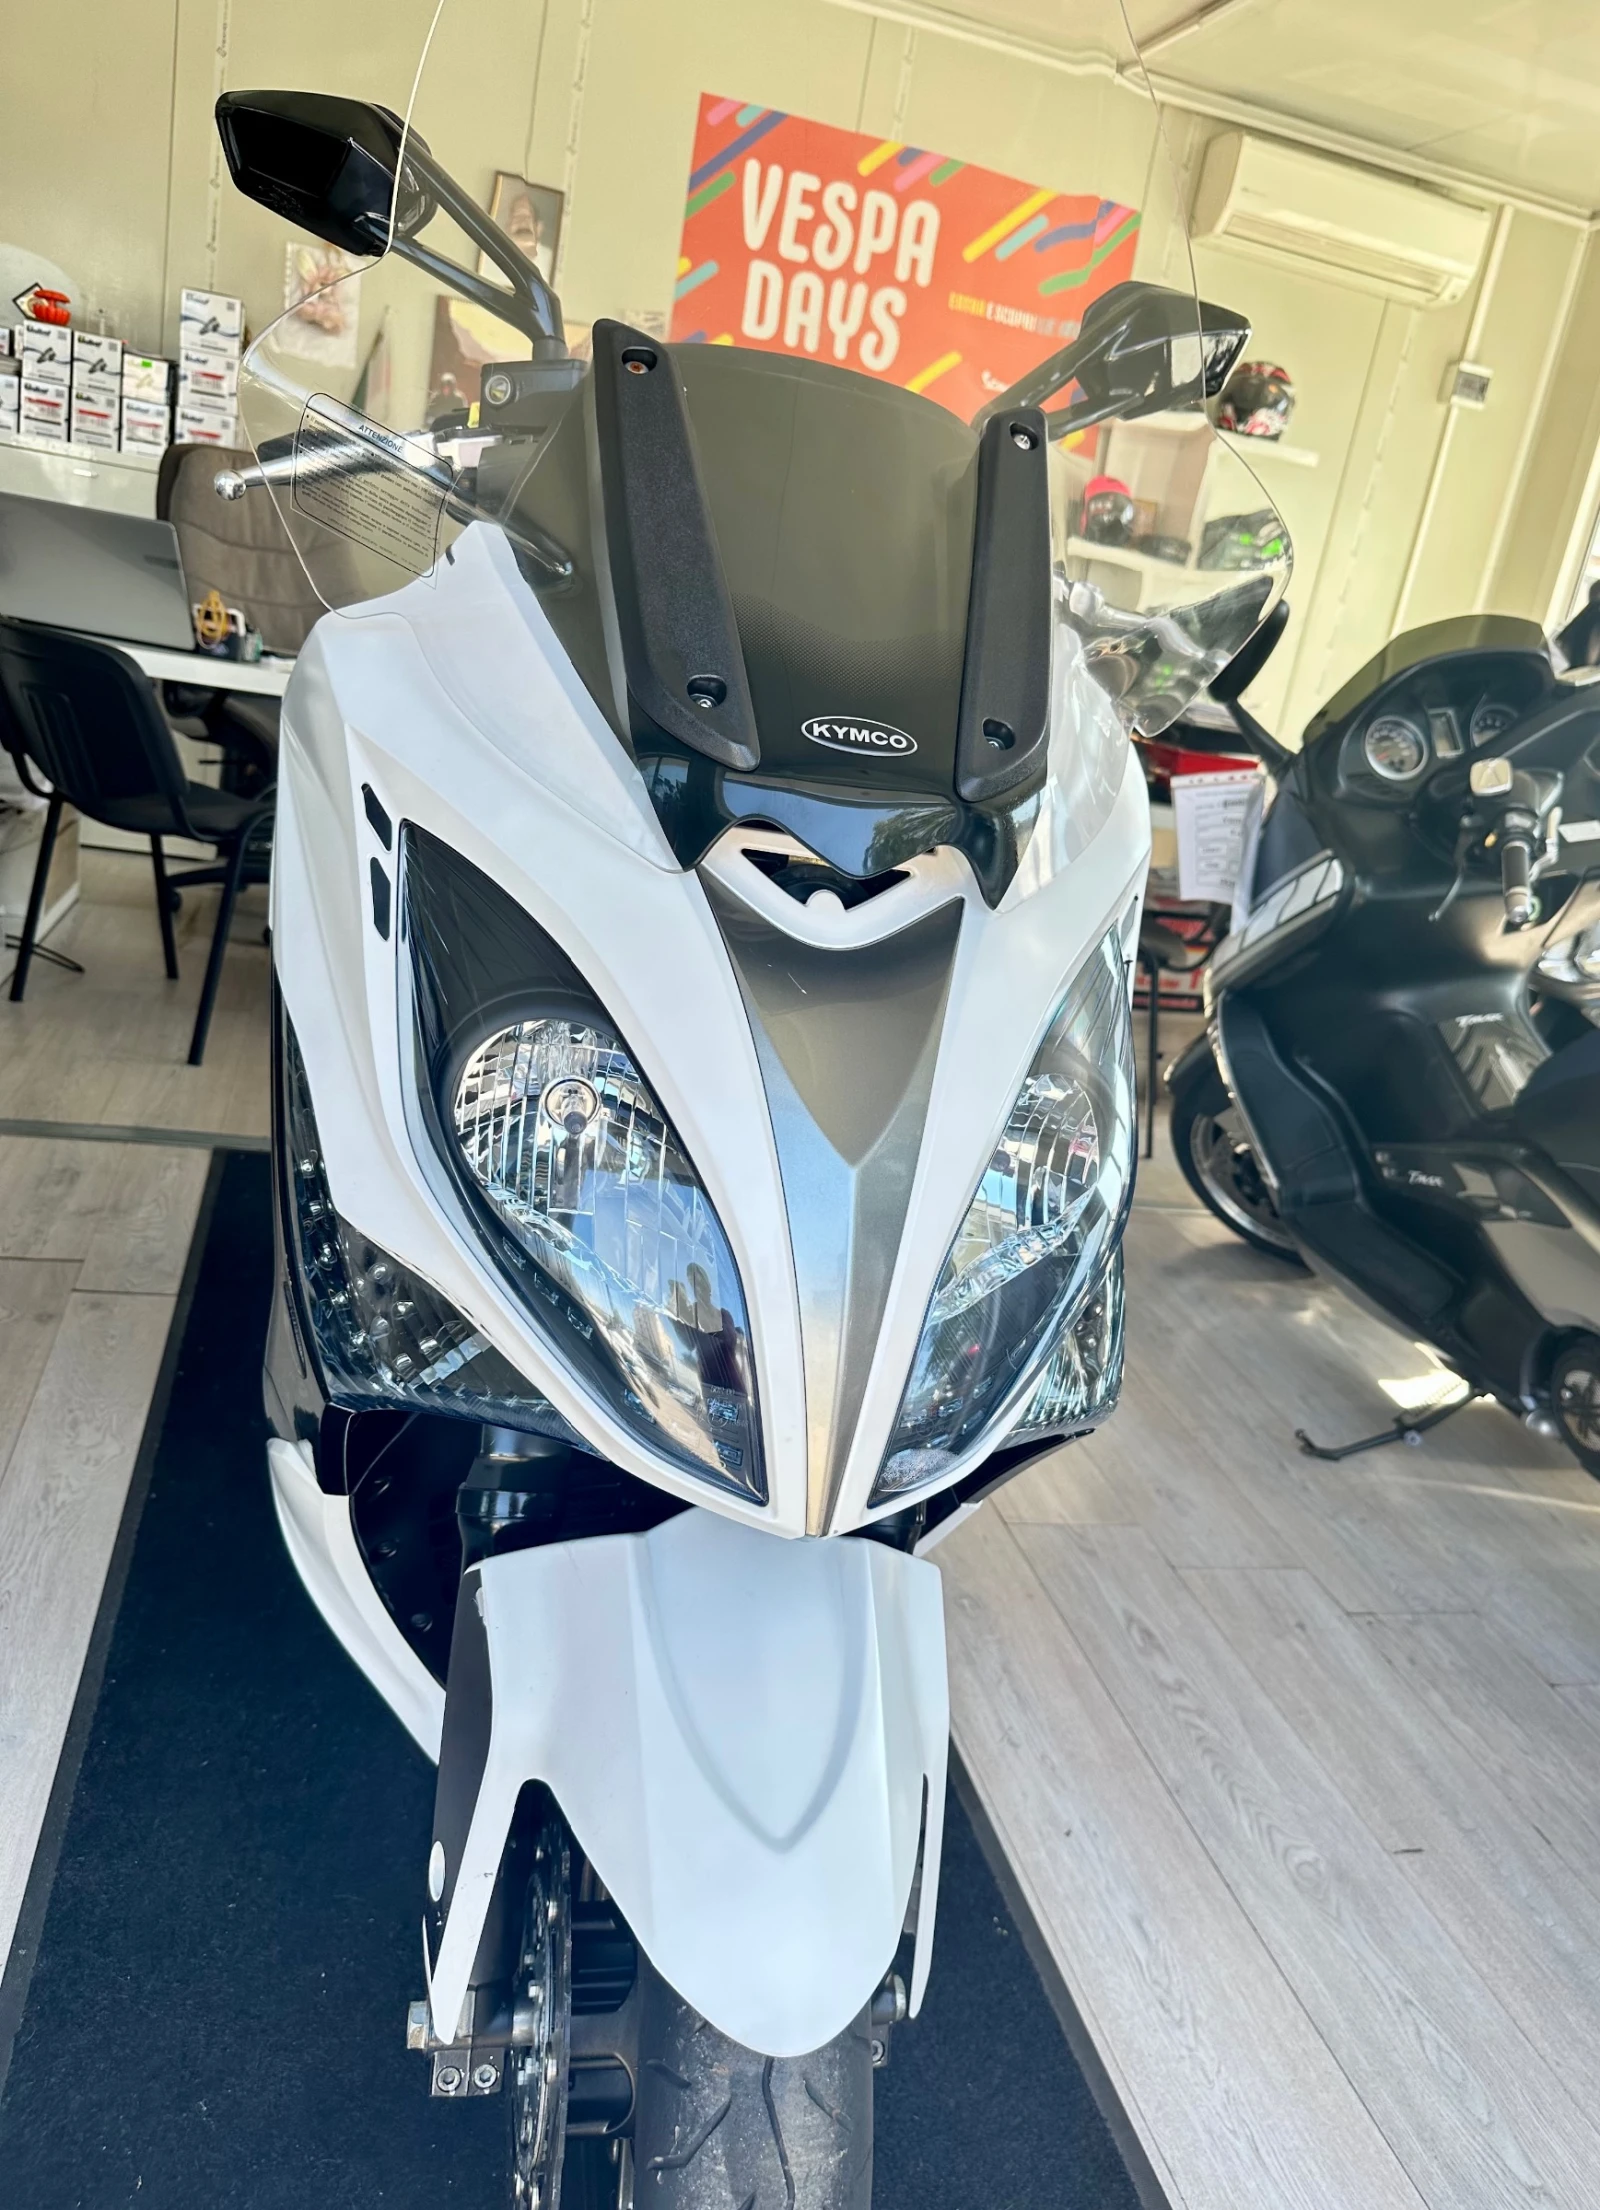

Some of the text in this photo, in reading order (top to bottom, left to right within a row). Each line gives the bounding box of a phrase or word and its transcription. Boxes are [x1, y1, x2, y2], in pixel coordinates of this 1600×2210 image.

[742, 158, 941, 288] VESPA
[741, 259, 908, 372] DAYS
[358, 423, 404, 454] ATTENZIONE
[811, 722, 908, 749] KYMCO
